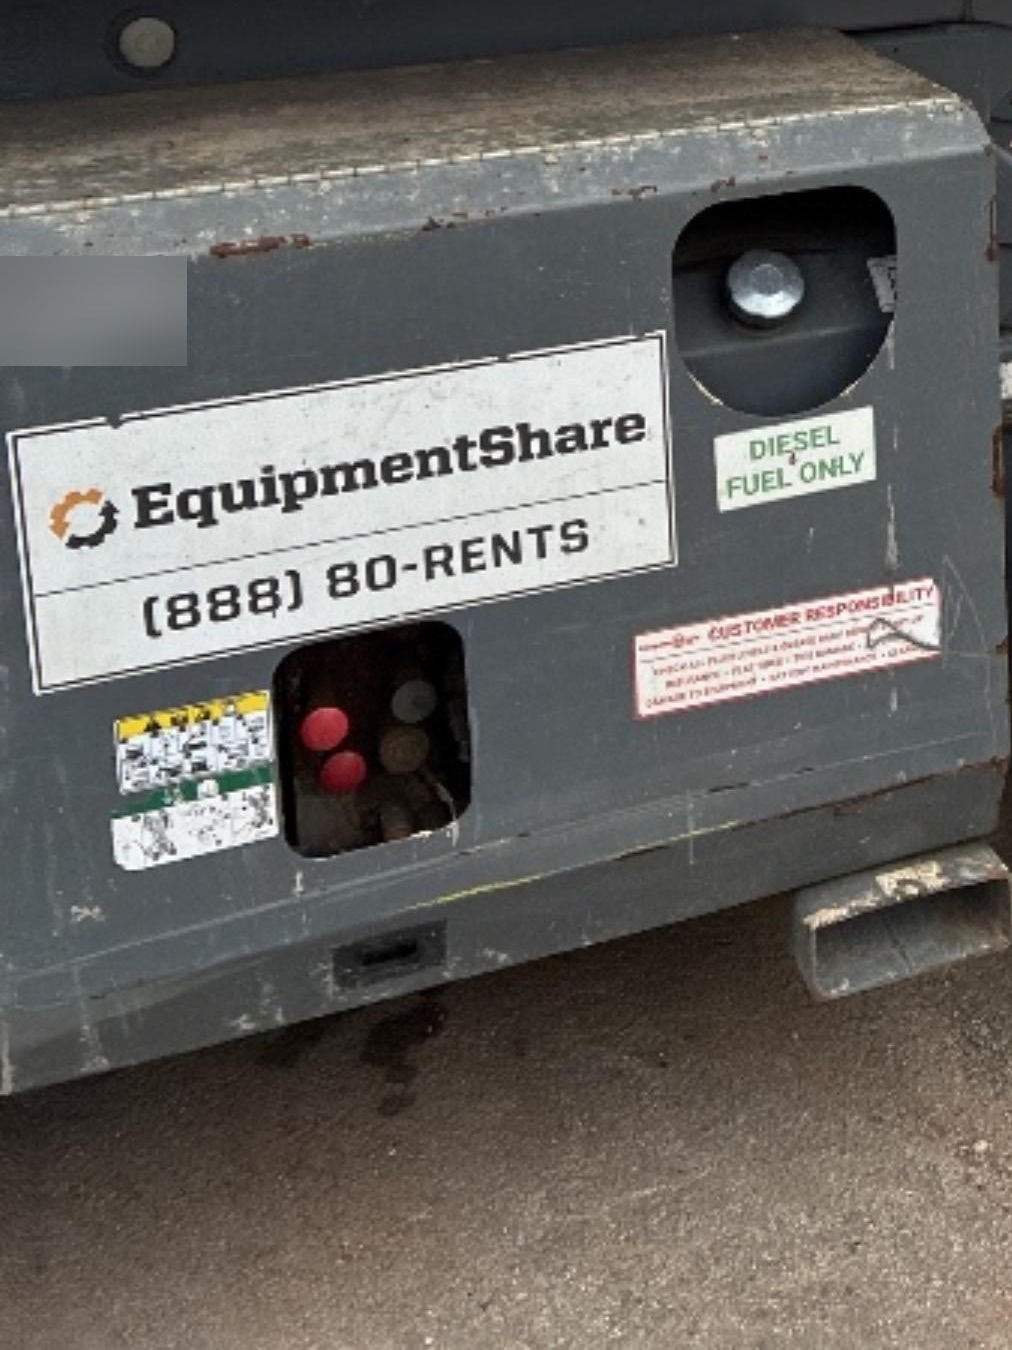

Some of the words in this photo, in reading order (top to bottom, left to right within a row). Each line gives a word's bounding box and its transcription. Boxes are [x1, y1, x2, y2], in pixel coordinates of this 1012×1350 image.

[749, 425, 841, 461] DIESEL
[131, 413, 647, 529] EquipmentShare
[725, 467, 793, 499] FUEL
[800, 450, 865, 484] ONLY
[142, 568, 304, 640] (888)
[326, 517, 590, 600] 80-RENTS
[708, 613, 802, 641] CUSTOMER
[805, 586, 935, 621] RESPONSIBILITY
